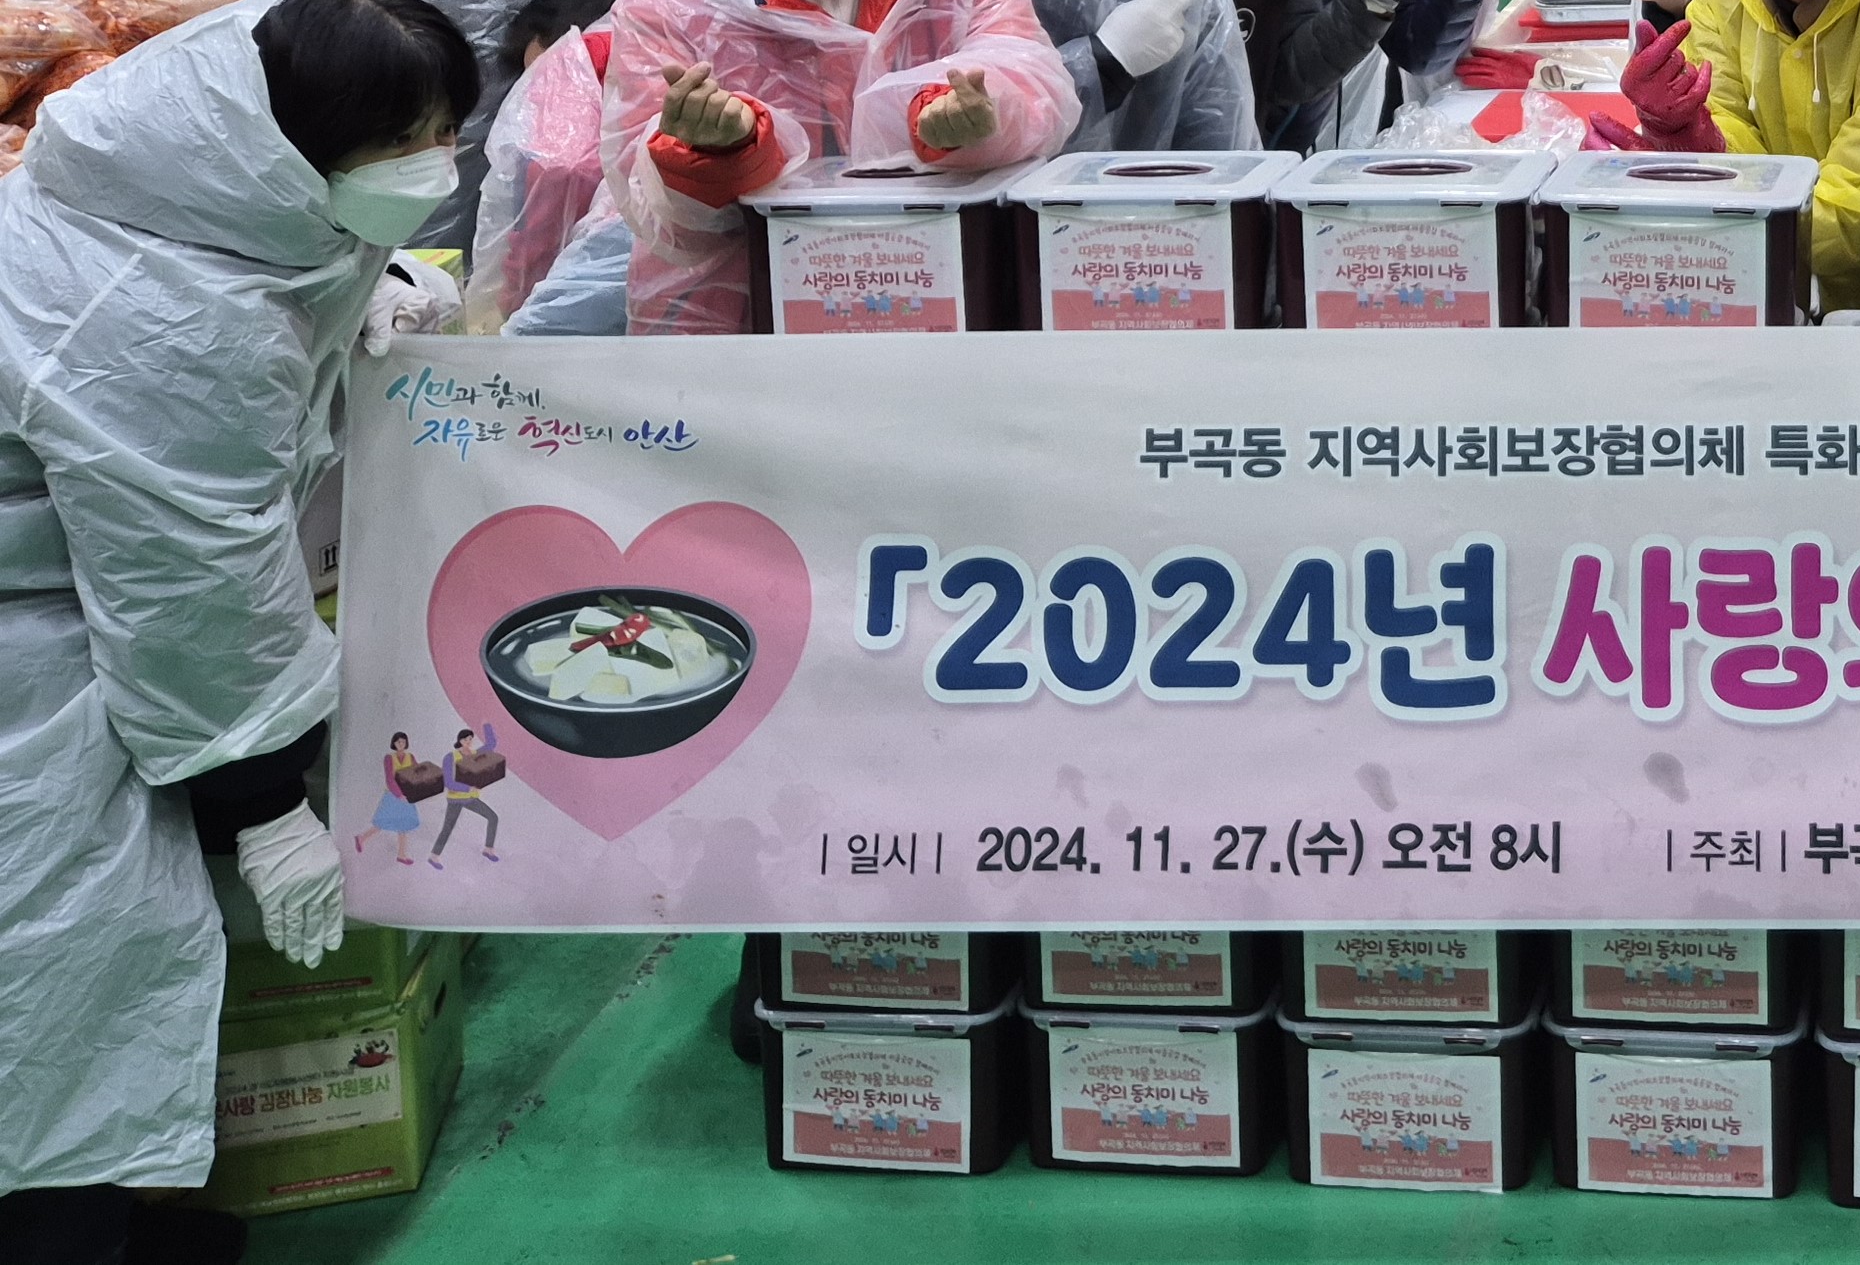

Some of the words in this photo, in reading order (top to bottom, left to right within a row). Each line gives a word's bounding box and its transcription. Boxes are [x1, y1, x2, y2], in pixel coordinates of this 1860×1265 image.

[385, 366, 483, 422] 시민과
[413, 417, 508, 463] 자유로운
[517, 416, 613, 457] 혁신도시
[623, 419, 700, 452] 안산
[1139, 426, 1287, 480] 부곡동
[1307, 423, 1746, 479] 지역사회보장협의체
[976, 827, 1102, 874] 2024.
[1125, 824, 1193, 875] 11.
[1211, 819, 1366, 877] 27.(수)
[1382, 819, 1474, 876] 오전
[1488, 821, 1563, 876] 8시
